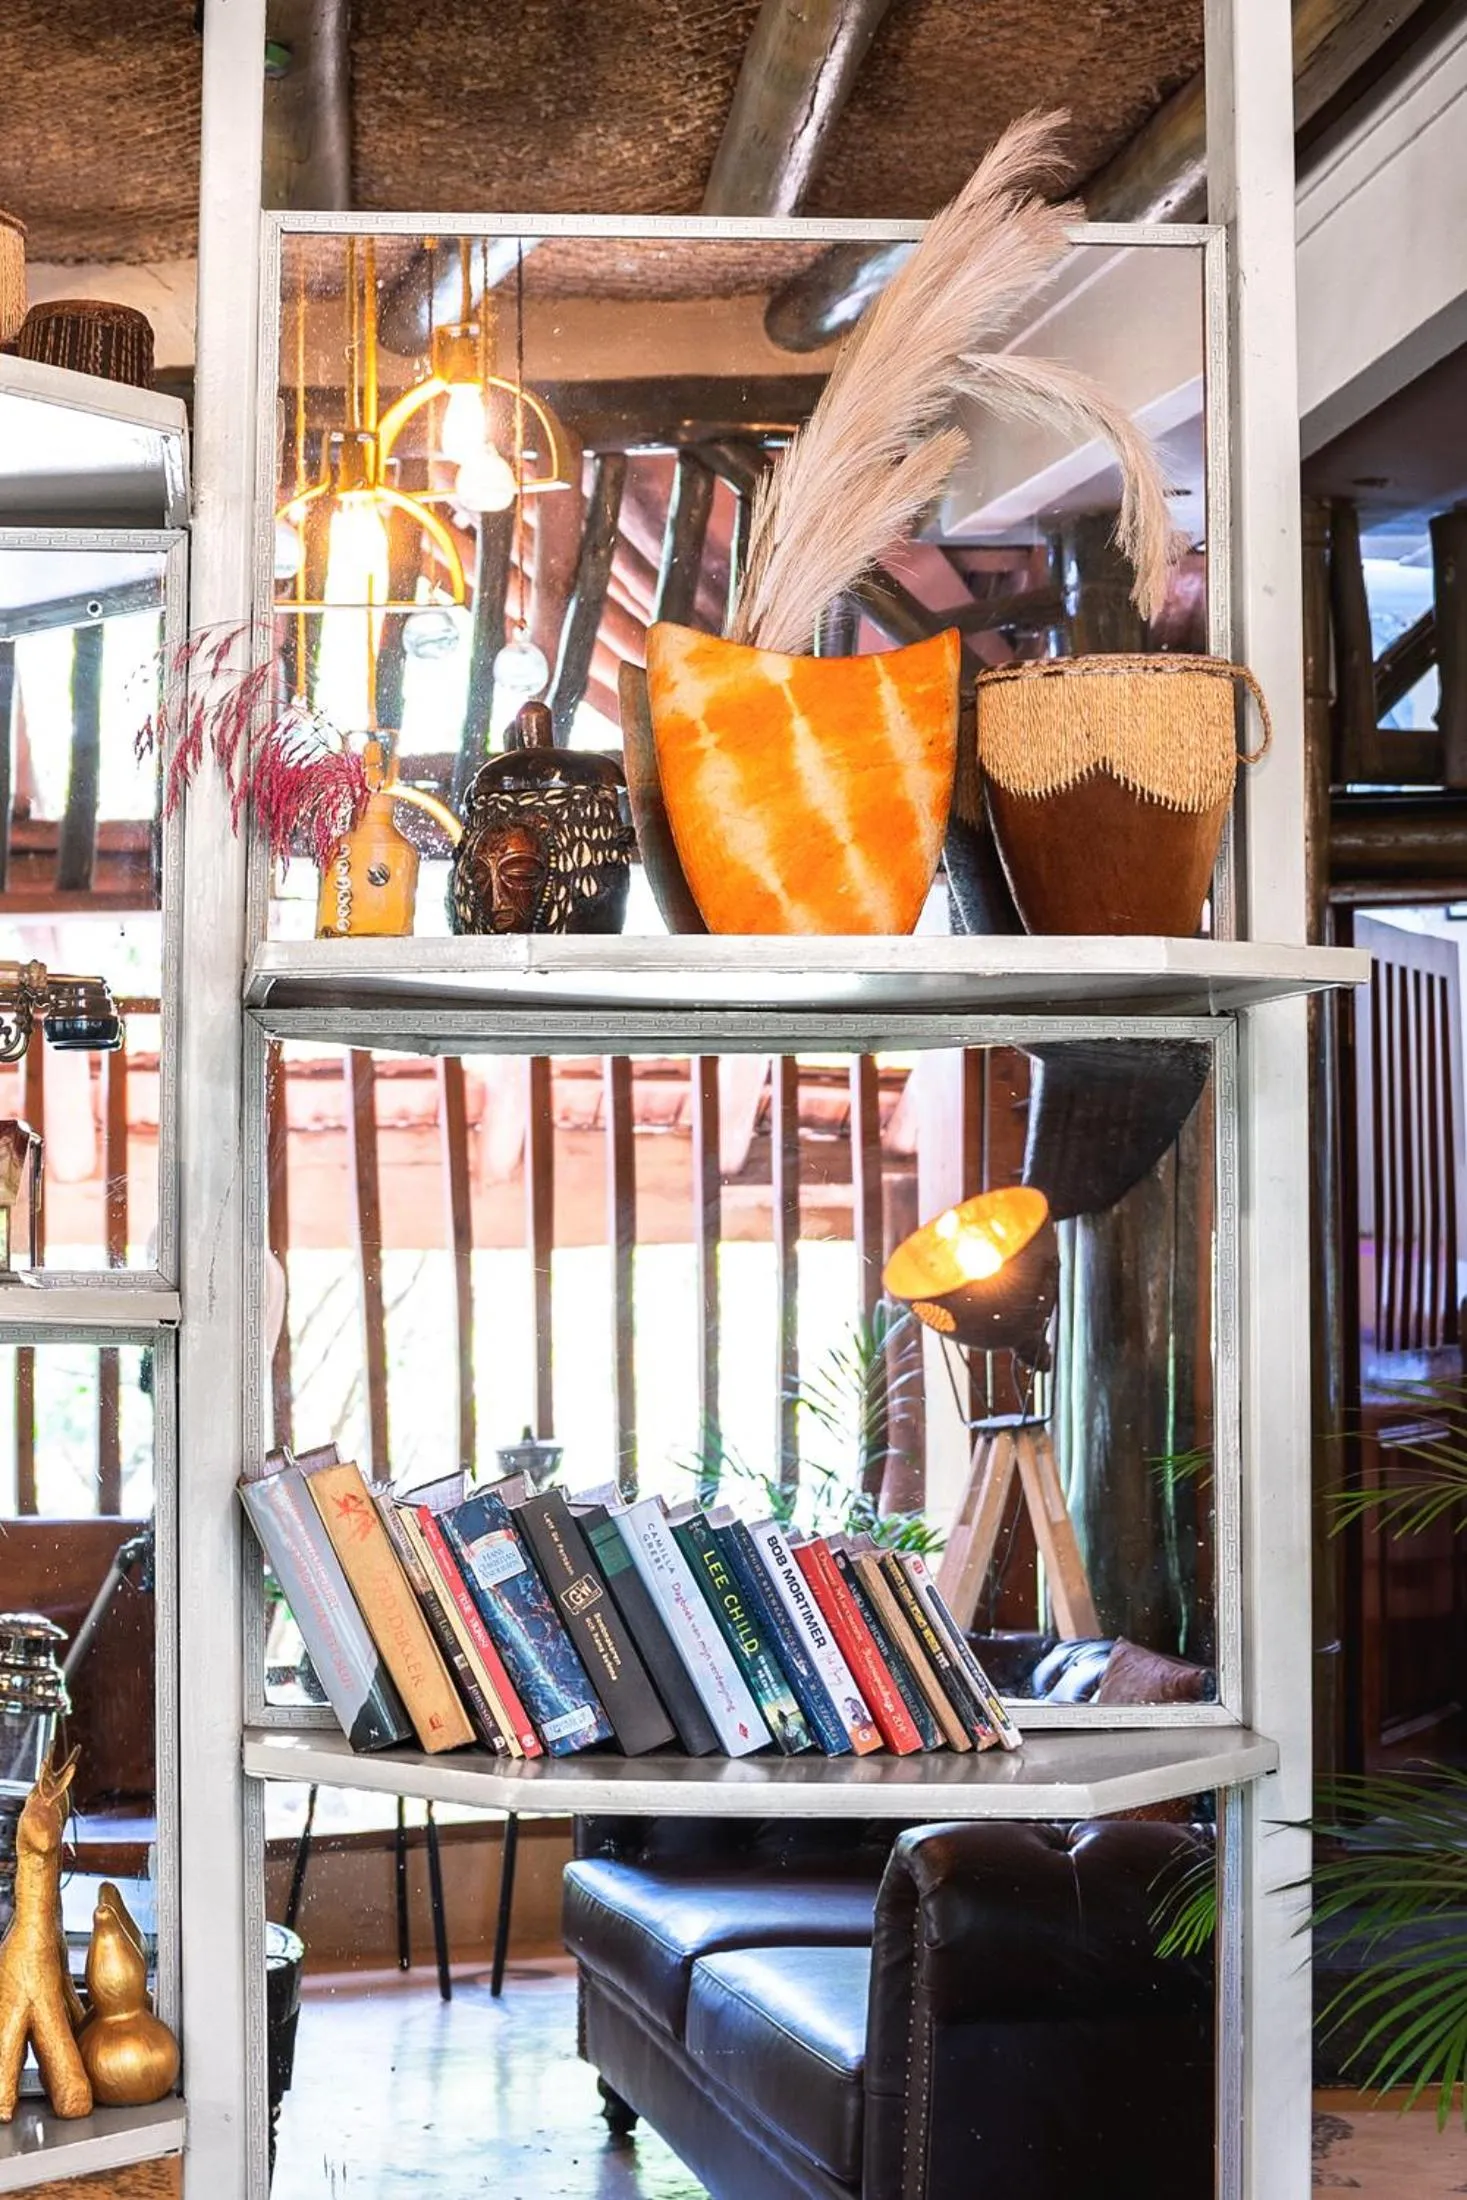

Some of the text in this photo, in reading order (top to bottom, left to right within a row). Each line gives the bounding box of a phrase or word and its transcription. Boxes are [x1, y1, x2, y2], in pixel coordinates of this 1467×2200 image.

[642, 1532, 664, 1572] GREBE
[646, 1521, 675, 1574] CAMILLA
[669, 1581, 695, 1622] Dagboek
[701, 1549, 760, 1654] LEE CHILD
[766, 1535, 827, 1649] BOB MORTIMER
[385, 1612, 430, 1688] DEKKER
[689, 1622, 702, 1639] van
[695, 1639, 712, 1662] mijn
[886, 1659, 903, 1683] KING
